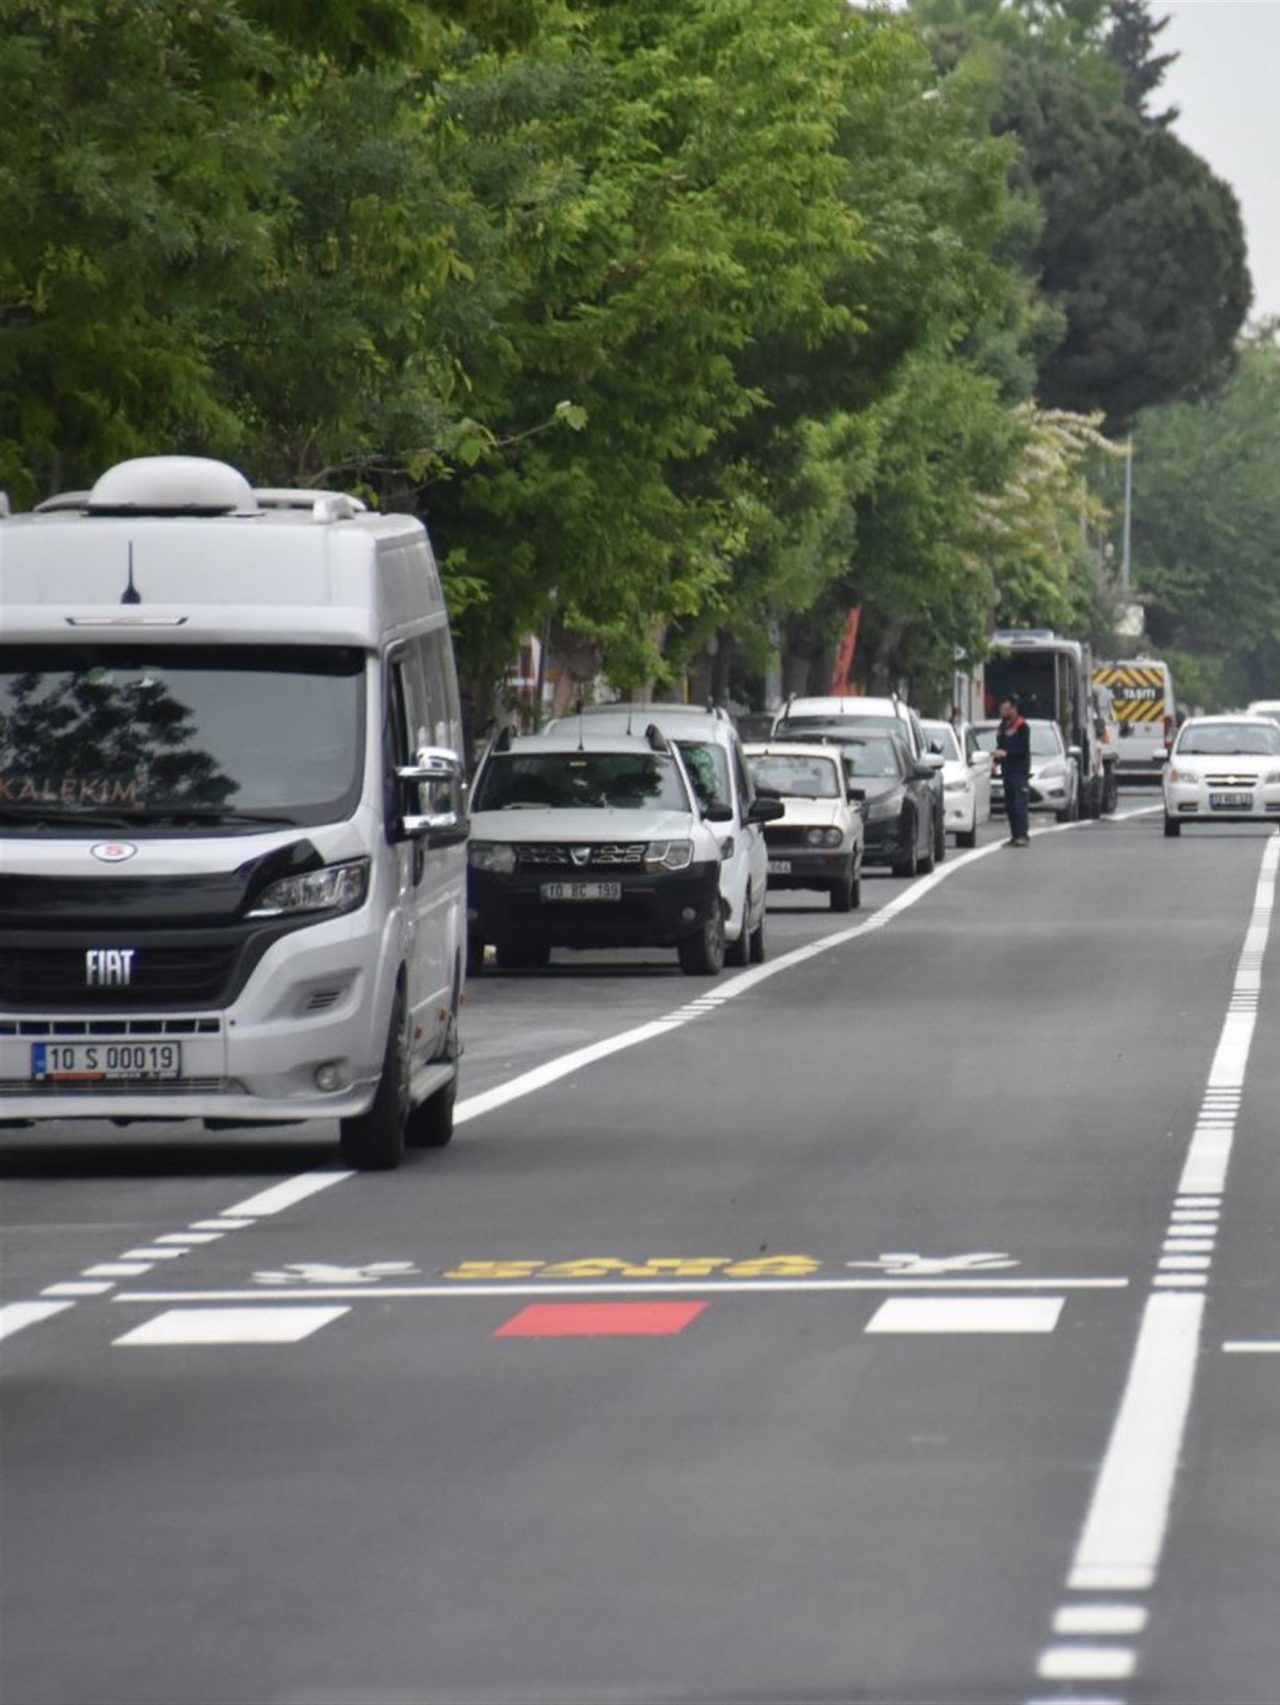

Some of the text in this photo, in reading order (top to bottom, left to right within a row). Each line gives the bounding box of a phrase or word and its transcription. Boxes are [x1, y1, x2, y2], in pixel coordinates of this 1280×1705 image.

[549, 883, 564, 897] 10
[86, 949, 135, 986] FIAT
[50, 1046, 173, 1070] 10 S 00019
